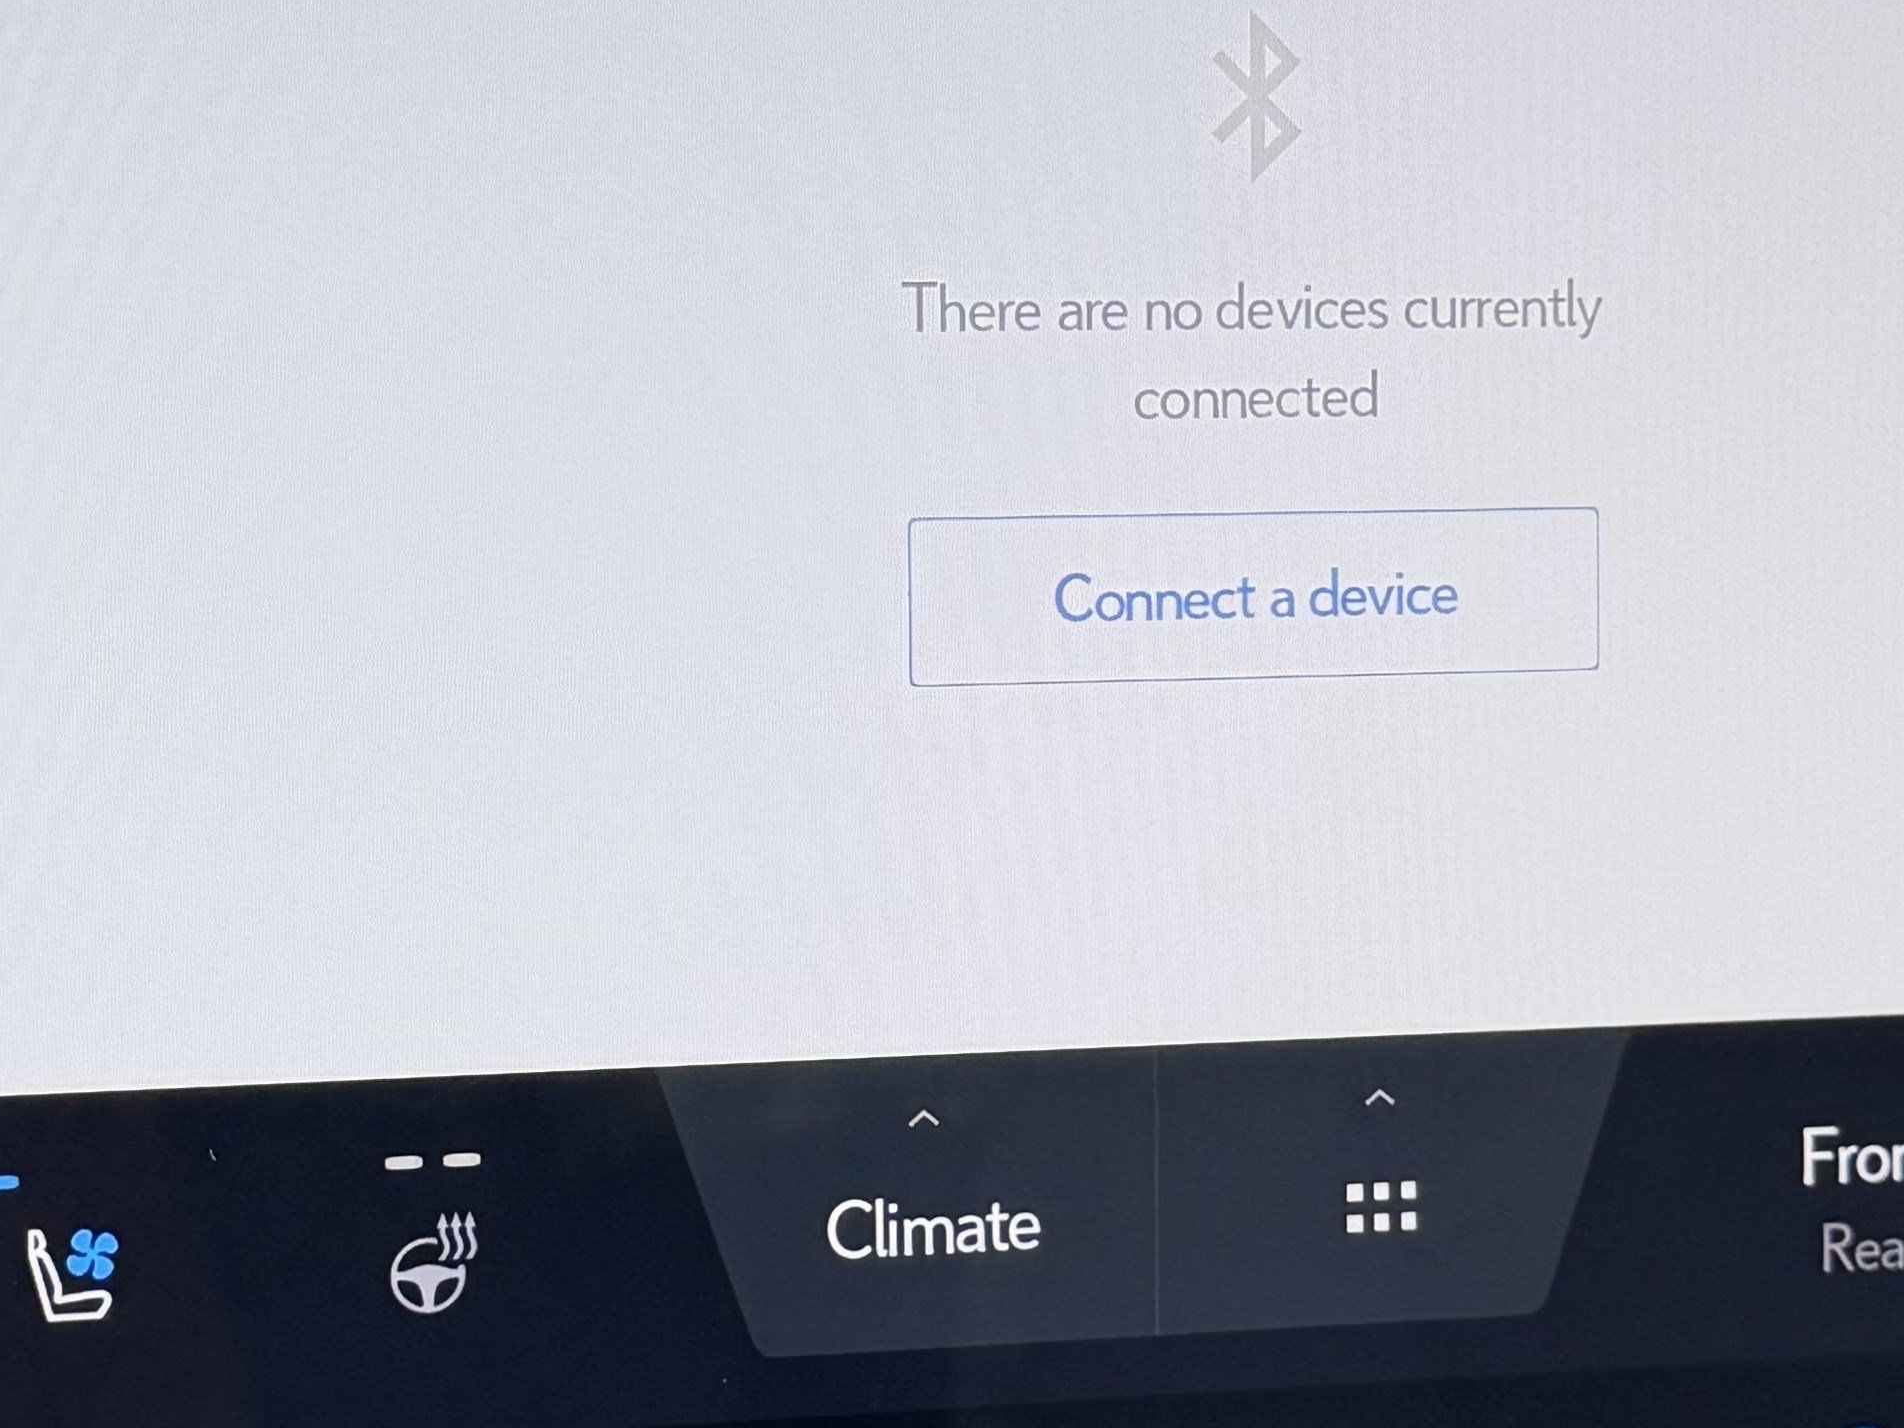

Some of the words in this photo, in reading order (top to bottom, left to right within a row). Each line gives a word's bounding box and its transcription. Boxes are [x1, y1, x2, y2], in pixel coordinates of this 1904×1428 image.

[900, 280, 1042, 334] There
[1057, 299, 1129, 332] are
[1145, 299, 1203, 332] no
[1215, 280, 1390, 331] devices
[1403, 276, 1604, 341] currently
[1133, 367, 1379, 421] connected
[1054, 571, 1257, 623] Connect
[1269, 586, 1296, 619] a
[1308, 566, 1459, 618] device
[826, 1196, 1043, 1261] Climate
